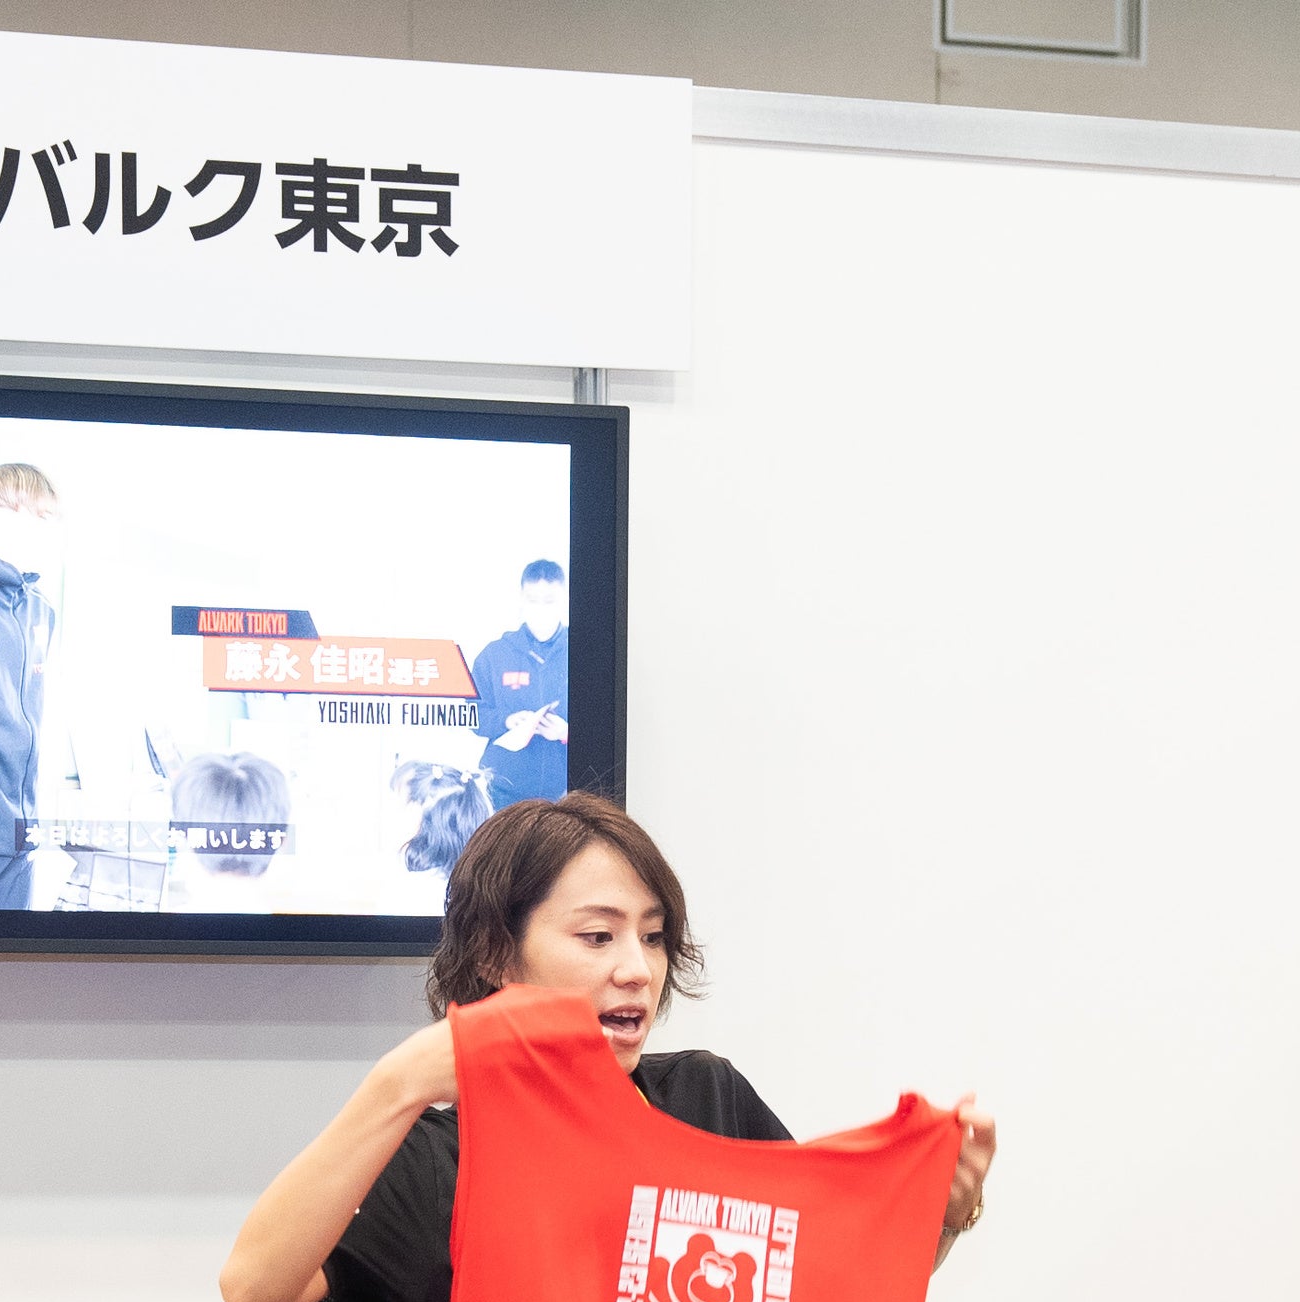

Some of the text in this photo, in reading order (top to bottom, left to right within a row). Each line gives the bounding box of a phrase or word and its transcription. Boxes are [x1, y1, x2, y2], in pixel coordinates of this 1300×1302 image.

[198, 609, 288, 635] ALVARK TOKYO
[224, 641, 302, 682] 藤永
[318, 700, 479, 727] YOSHIAKI FUJINAGA
[659, 1187, 772, 1236] ALVARK TOKYO
